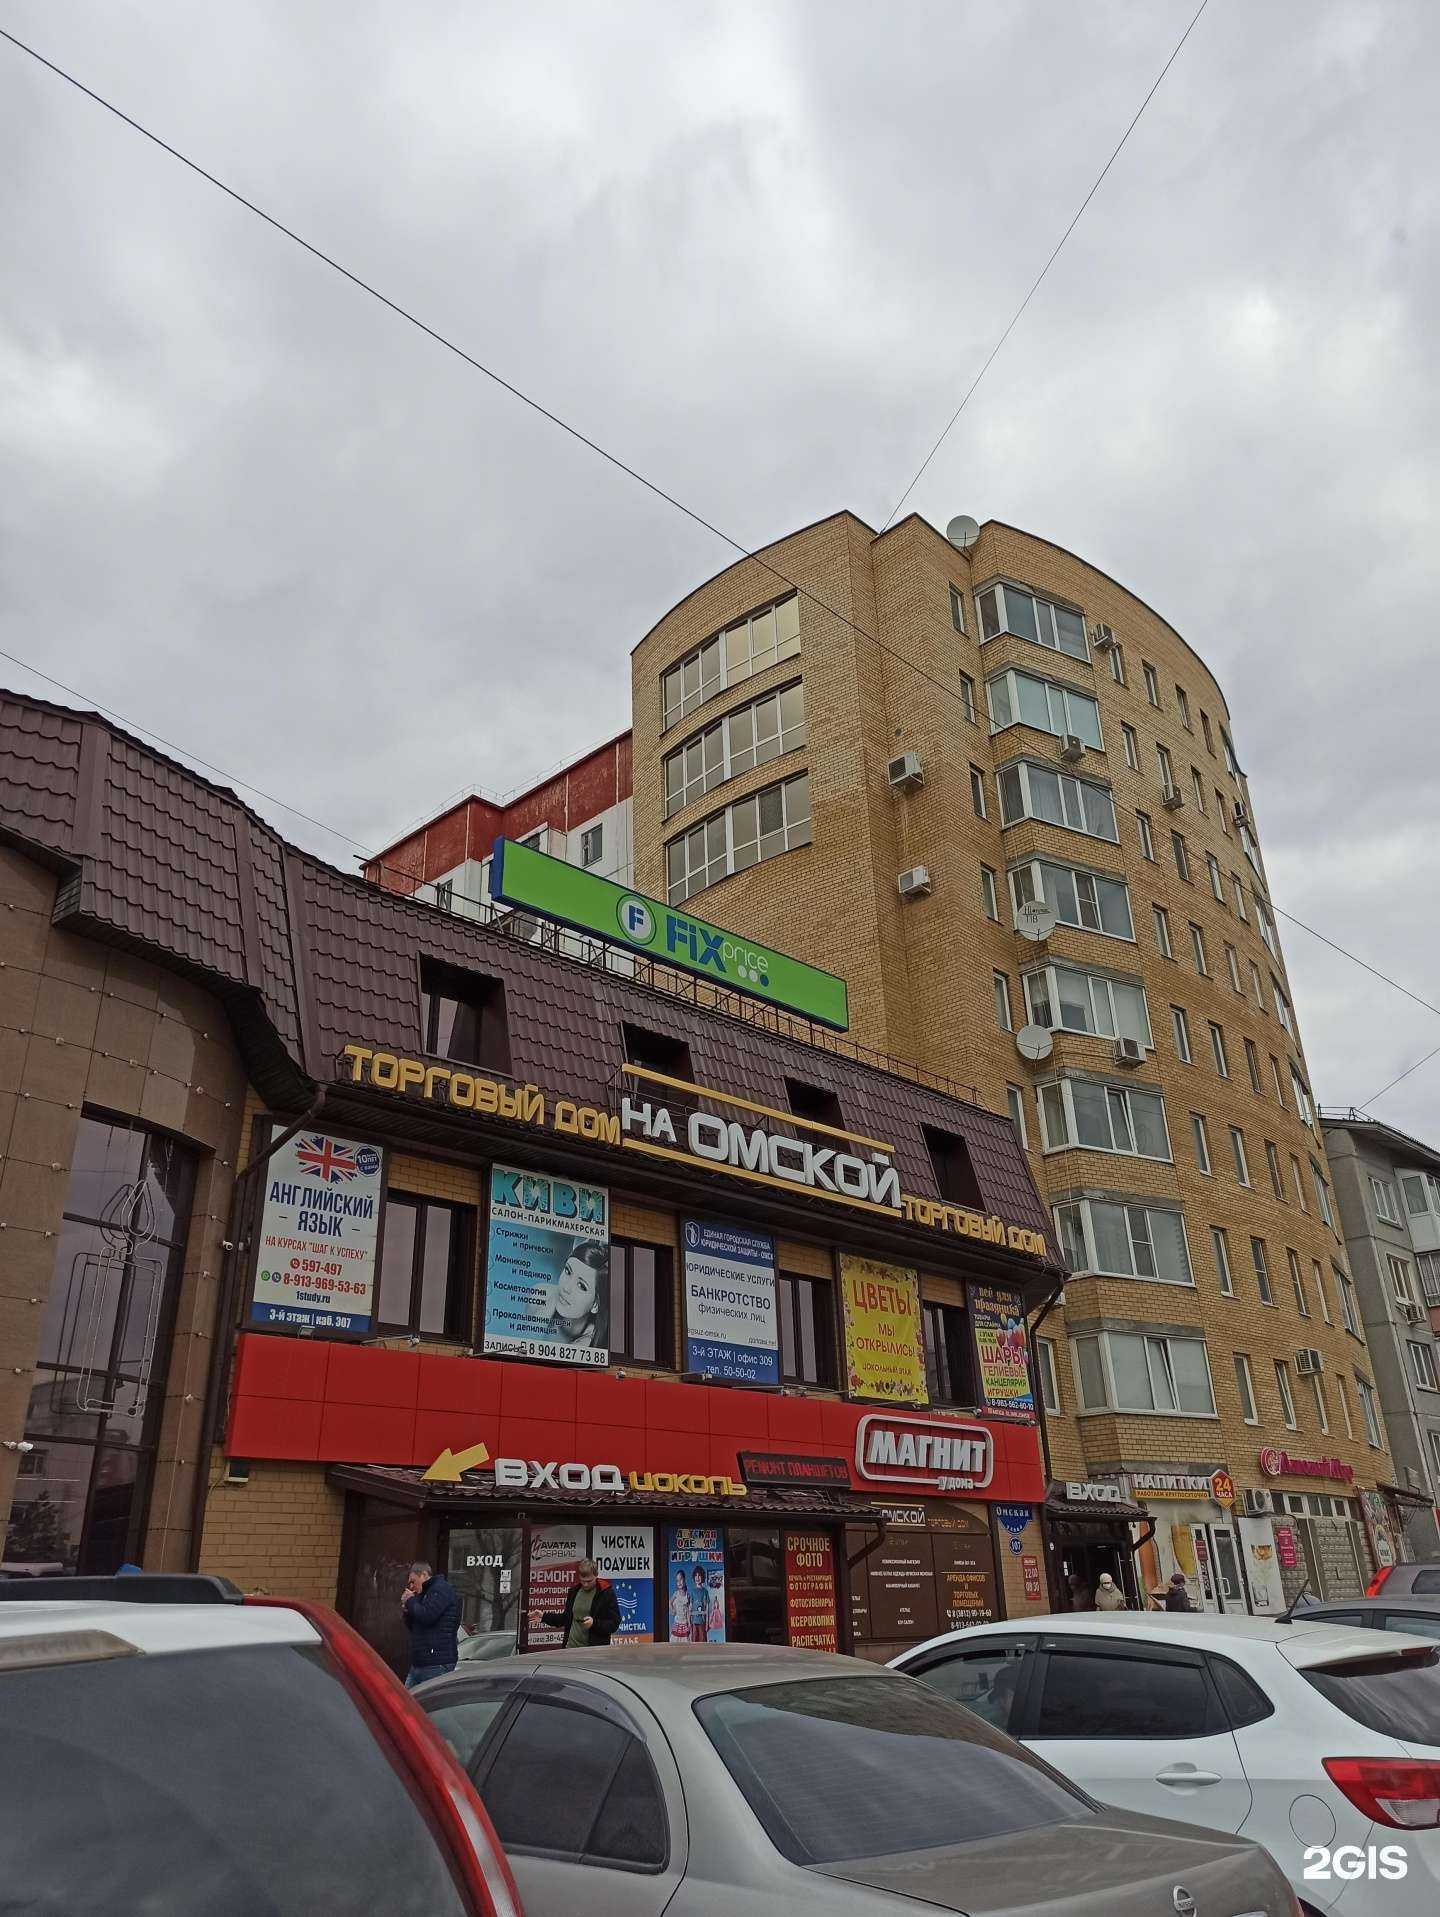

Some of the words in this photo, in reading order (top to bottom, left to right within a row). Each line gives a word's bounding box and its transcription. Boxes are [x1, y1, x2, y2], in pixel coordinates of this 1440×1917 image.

[722, 941, 769, 974] price
[344, 1044, 545, 1125] ТОРГОВЫЙ
[554, 1100, 621, 1145] ДОМ
[621, 1097, 678, 1143] НА
[687, 1111, 900, 1208] ОМСКОЙ
[269, 1181, 374, 1219] АНГЛИЙСКИЙ
[492, 1168, 605, 1226] КИВИ
[297, 1210, 344, 1237] ЯЗЫК
[491, 1207, 605, 1237] САЛОН-ПАРИКМАХЕРСКАЯ
[901, 1194, 1006, 1246] ТОРГОВЫЙ
[1006, 1223, 1047, 1257] ДОМ
[495, 1227, 529, 1241] Стрижки
[703, 1229, 723, 1240] ЕДИНАЯ
[724, 1233, 751, 1246] ГОРОДСКАЯ
[751, 1240, 770, 1250] СЛУЖБА
[265, 1235, 276, 1247] НА
[277, 1236, 307, 1251] КУРСАХ
[330, 1245, 336, 1256] К
[519, 1242, 554, 1254] прически
[301, 1259, 343, 1275] 597-497
[495, 1254, 531, 1268] Маникюр
[518, 1269, 552, 1281] педикюр
[687, 1262, 745, 1281] ЮРИДИЧЕСКИЕ
[747, 1274, 774, 1287] УСЛУГИ
[283, 1273, 367, 1295] 8-913-969-53-63
[493, 1281, 547, 1296] Косметология
[296, 1290, 331, 1304] 1study.ru
[517, 1296, 547, 1306] массаж
[691, 1284, 771, 1310] БАНКРОТСТВО
[852, 1279, 912, 1316] ЦВЕТЫ
[287, 1311, 311, 1324] этаж
[335, 1317, 351, 1328] 307
[492, 1308, 551, 1325] Прокалывание
[698, 1303, 748, 1320] физических
[750, 1311, 766, 1324] лиц
[516, 1322, 557, 1335] депиляция
[878, 1323, 895, 1337] МЫ
[529, 1343, 535, 1355] 8
[538, 1344, 556, 1357] 904
[559, 1346, 577, 1360] 827
[580, 1350, 592, 1362] 73
[594, 1351, 606, 1363] 88
[707, 1347, 732, 1361] ЭТАЖ
[737, 1354, 758, 1365] офис
[759, 1354, 773, 1367] 309
[980, 1345, 1024, 1366] ШАРЫ
[723, 1366, 757, 1380] 50-50-02
[984, 1366, 1026, 1377] ГЕЛИЕВЫЕ
[985, 1378, 1027, 1387] КАНЦЕЛЯРИЯ
[988, 1388, 1019, 1397] ИГРУШКИ
[866, 1430, 986, 1473] МАГНИТ
[494, 1457, 625, 1491] ВХОД
[628, 1471, 747, 1496] ЦОКОЛЬ
[948, 1477, 974, 1490] дома
[1133, 1473, 1210, 1489] НАПИТКИ
[1066, 1481, 1126, 1502] ВХОД
[1215, 1478, 1232, 1491] 24
[996, 1506, 1030, 1517] Омская
[677, 1528, 717, 1539] ДЕТСКАЯ
[540, 1541, 577, 1549] AVATAR
[601, 1535, 645, 1549] ЧИСТКА
[676, 1539, 717, 1549] ОДЕЖДА
[787, 1536, 831, 1552] СРОЧНОЕ
[540, 1549, 577, 1557] СЕРВИС
[671, 1551, 723, 1562] ИГРУШКИ
[796, 1552, 823, 1568] ФОТО
[466, 1554, 504, 1568] ВХОД
[596, 1557, 651, 1571] ПОДУШЕК
[529, 1570, 577, 1583] РЕМОНТ
[946, 1574, 966, 1583] АРЕНДА
[789, 1582, 833, 1591] ФОТОГРАФИЙ
[528, 1598, 568, 1606] ПЛАНШЕТ
[790, 1598, 835, 1609] ФОТОСУВЕНИРЫ
[790, 1615, 835, 1627] КСЕРОКОПИЯ
[792, 1634, 836, 1647] РАСПЕЧАТКА
